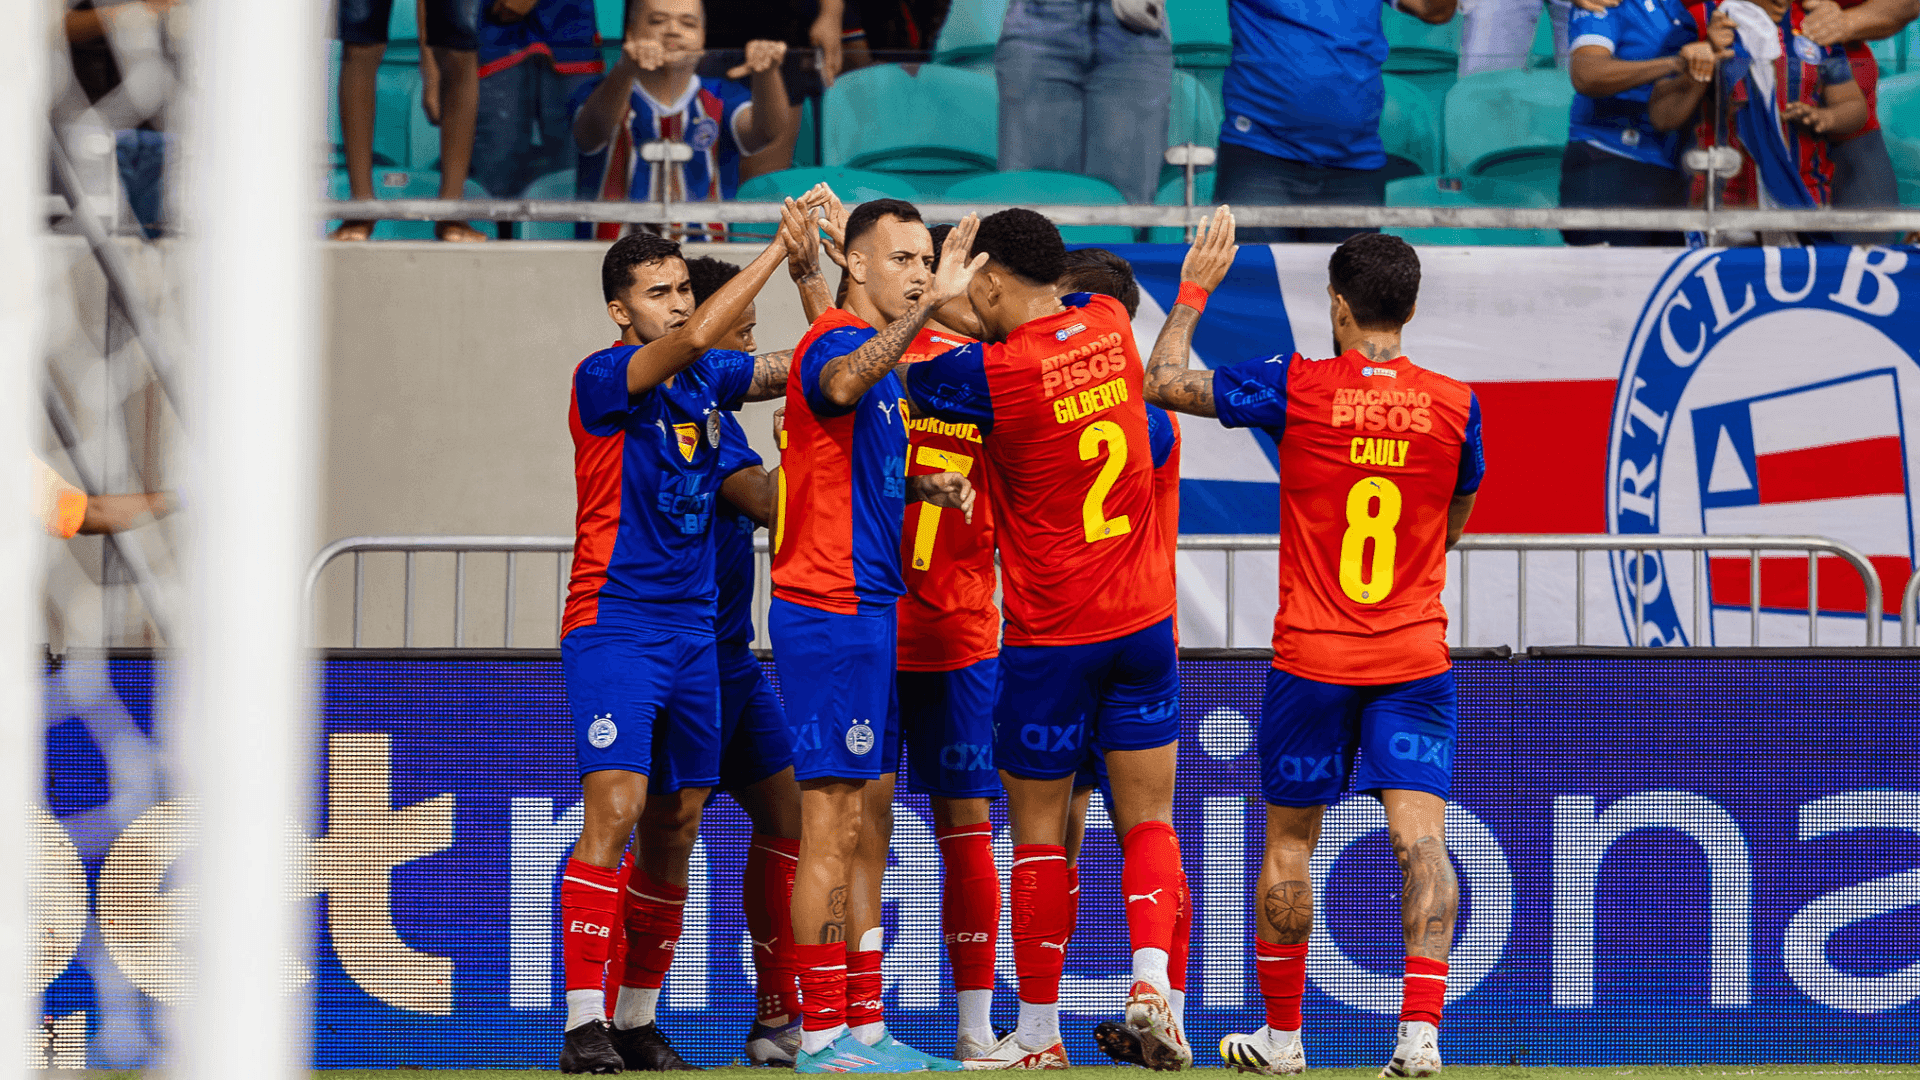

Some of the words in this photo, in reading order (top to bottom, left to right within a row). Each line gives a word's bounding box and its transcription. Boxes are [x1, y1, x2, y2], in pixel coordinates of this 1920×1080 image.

[1660, 246, 1908, 368] CLUB
[1042, 346, 1127, 397] PISOS
[1053, 377, 1128, 424] GILBERTO
[1333, 388, 1432, 409] ATACADÃO
[1332, 405, 1433, 433] PISOS
[1350, 437, 1410, 467] CAULY
[1078, 420, 1132, 543] 2
[904, 444, 974, 571] 7
[1338, 476, 1403, 605] 8
[1021, 713, 1086, 752] axi
[1389, 731, 1451, 769] axi
[1279, 746, 1344, 782] axi
[570, 920, 610, 938] ECB
[944, 932, 989, 944] ECB
